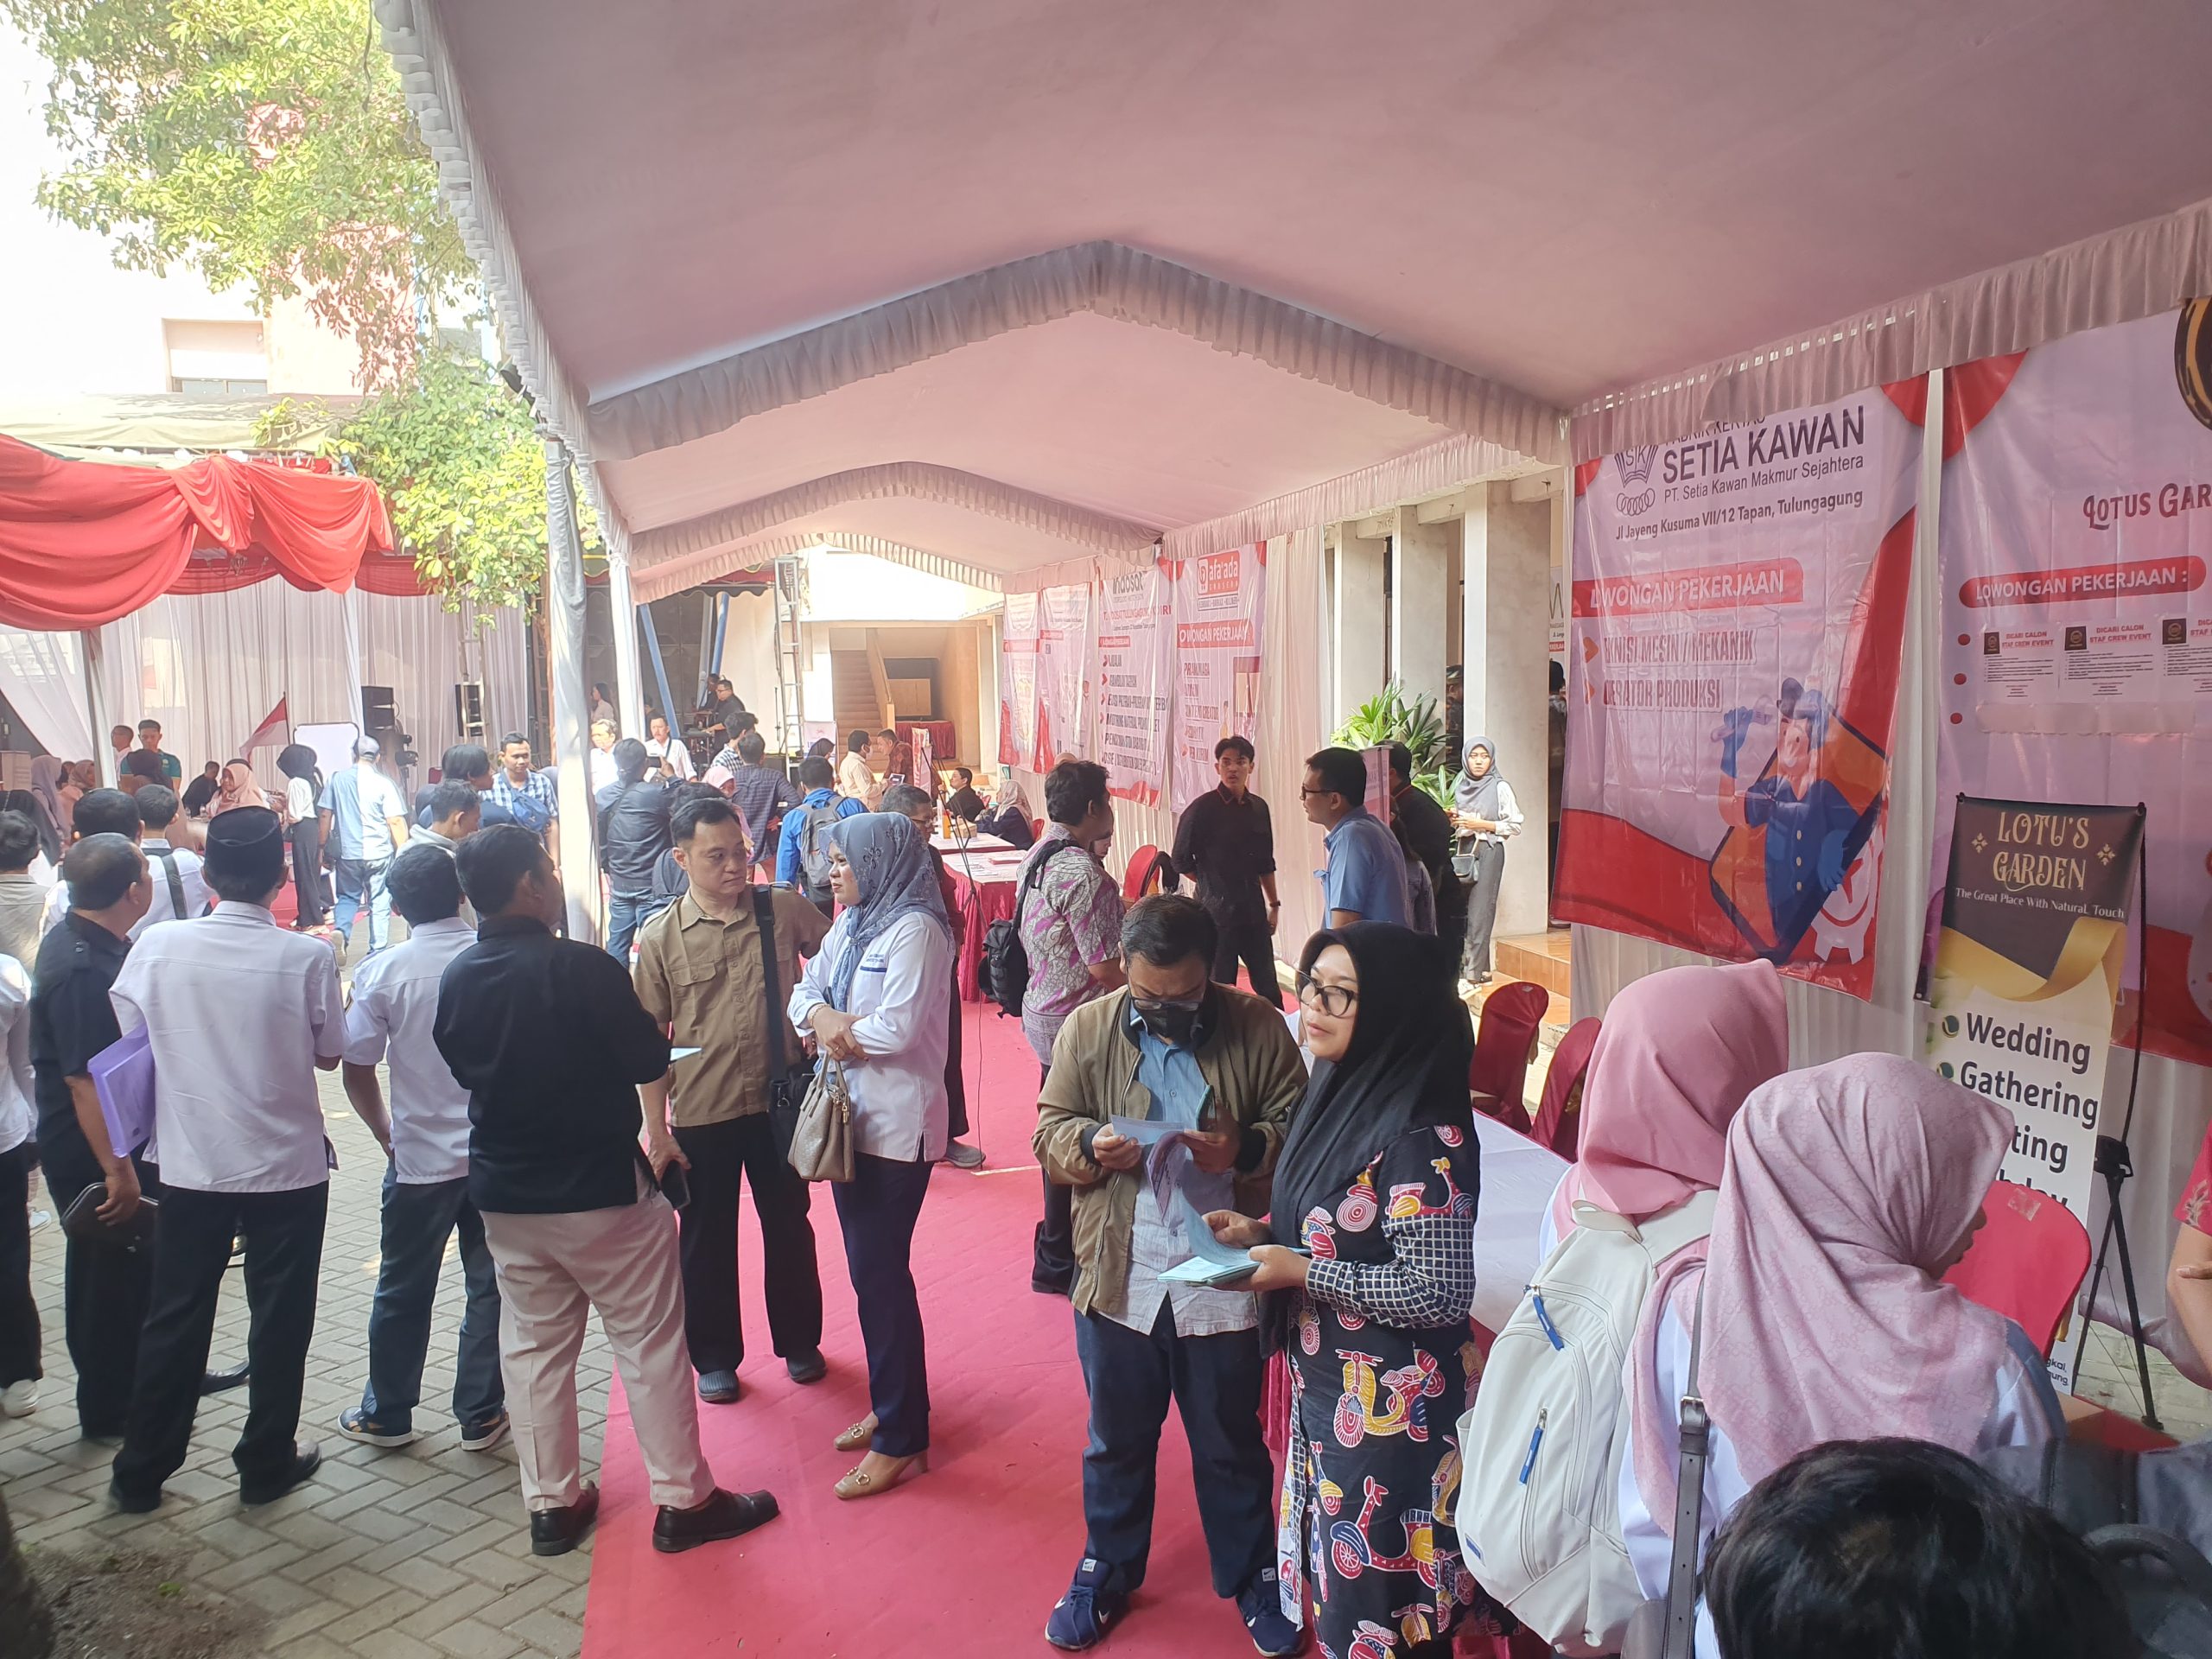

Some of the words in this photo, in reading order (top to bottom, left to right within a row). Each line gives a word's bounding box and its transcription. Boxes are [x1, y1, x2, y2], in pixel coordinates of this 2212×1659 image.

[1663, 435, 1739, 484] SETIA
[1748, 405, 1865, 467] KAWAN
[1664, 487, 1680, 504] PT.
[1683, 482, 1708, 500] Setia
[1712, 477, 1747, 496] Kawan
[1751, 468, 1797, 488] Makmur
[1802, 454, 1864, 480] Sejahtera
[1625, 523, 1658, 541] Jayeng
[1661, 517, 1700, 534] Kusuma
[1702, 507, 1735, 526] VII/12
[1738, 505, 1775, 524] Tapan,
[1777, 490, 1863, 515] Tulungagung
[1679, 569, 1784, 602] PEKERJAAN
[1976, 577, 2067, 601] LOWONGAN
[2071, 567, 2176, 593] PEKERJAAN
[1691, 629, 1754, 662] MEKANIK
[1656, 678, 1720, 709] PRODUKSI
[1998, 811, 2089, 849] LOTU'S
[1993, 851, 2087, 892] GARDEN
[1956, 887, 1972, 899] The
[1974, 890, 1998, 903] Great
[2000, 893, 2024, 906] Place
[2025, 896, 2049, 910] With
[2093, 904, 2125, 918] Touch
[1967, 1012, 2091, 1075] Wedding
[1961, 1061, 2098, 1130] Gathering
